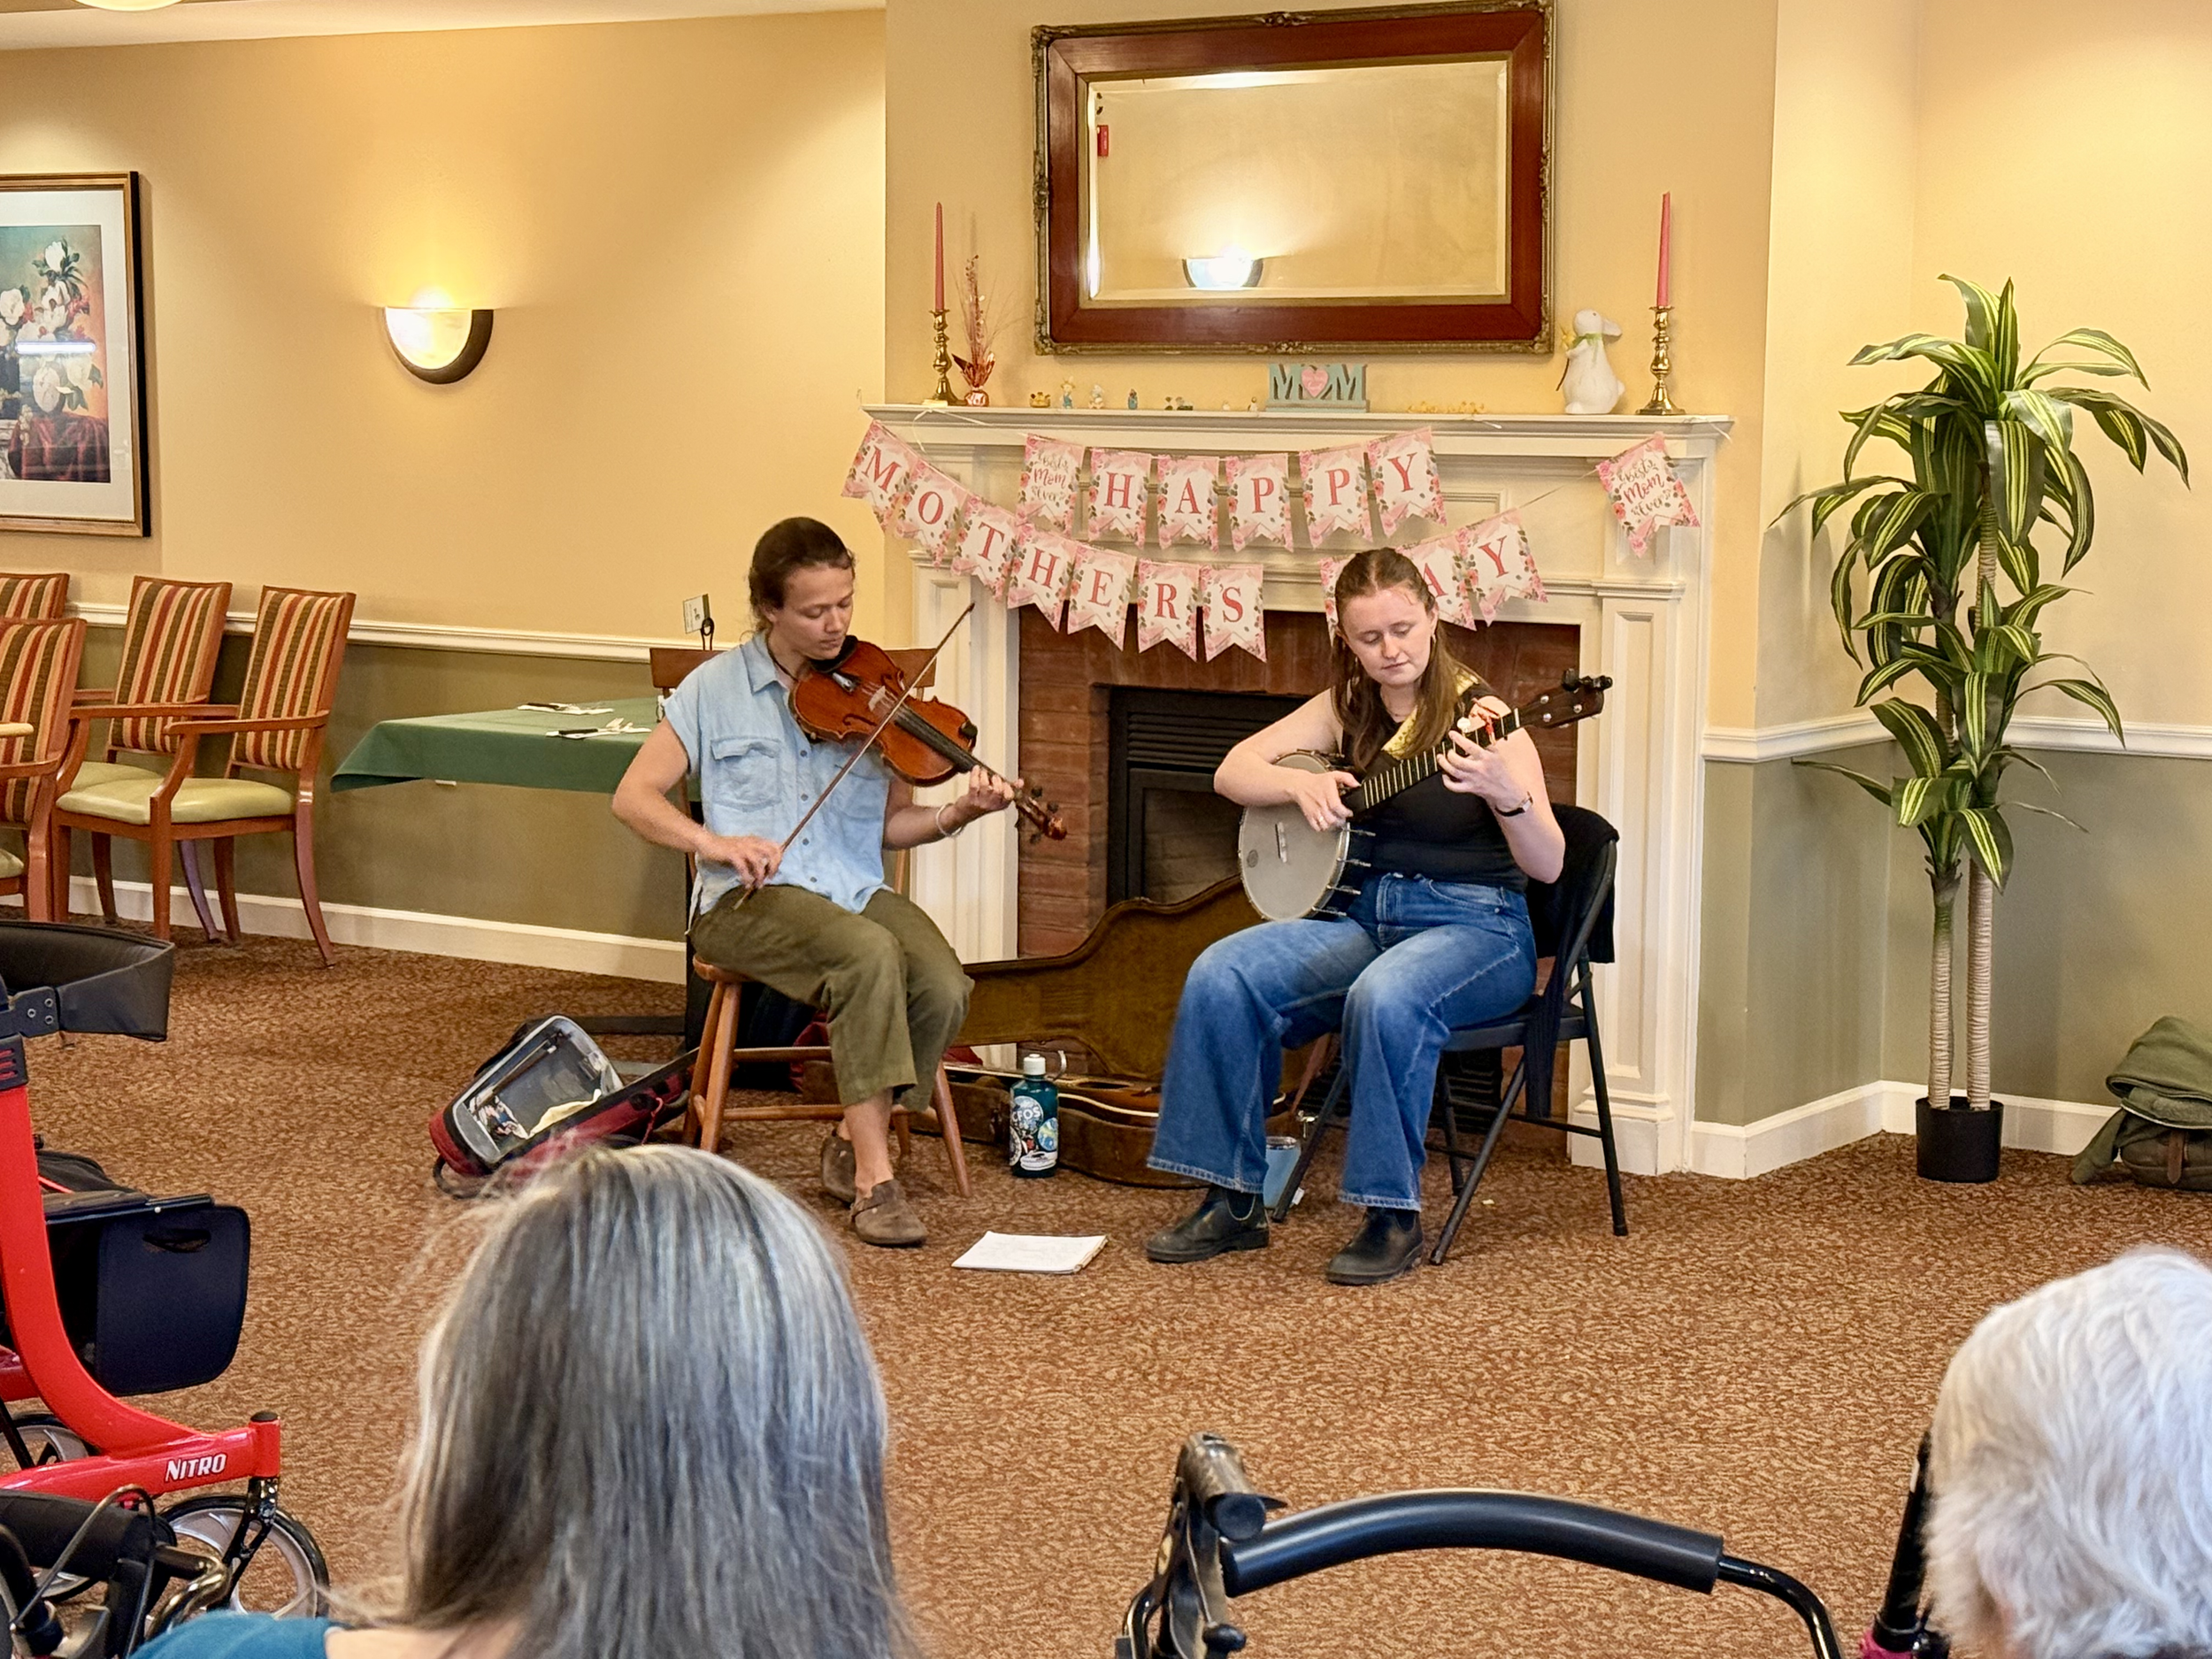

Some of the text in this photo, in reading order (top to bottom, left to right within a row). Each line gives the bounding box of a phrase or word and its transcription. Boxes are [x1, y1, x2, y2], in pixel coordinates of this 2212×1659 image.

[1033, 468, 1067, 490] Mom
[1104, 452, 1420, 515] HAPPY
[1623, 473, 1665, 505] Mom
[862, 446, 1509, 623] MOTHER'S AY
[165, 1454, 227, 1482] NITRO
